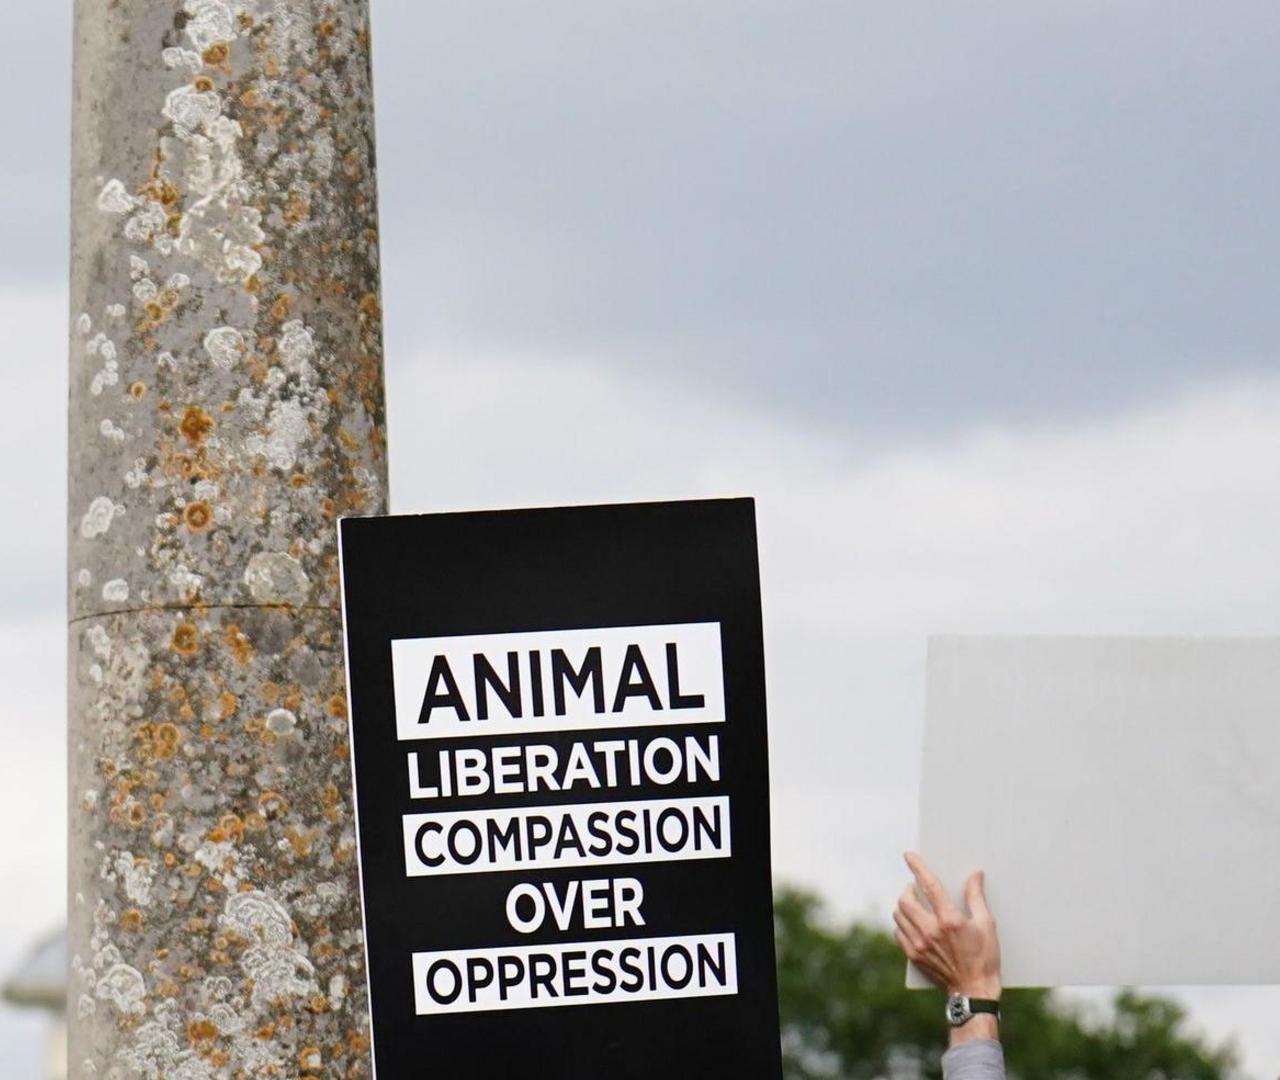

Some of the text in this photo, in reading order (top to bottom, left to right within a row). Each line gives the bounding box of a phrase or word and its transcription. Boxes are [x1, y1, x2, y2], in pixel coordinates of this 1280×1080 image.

[418, 643, 705, 724] ANIMAL
[408, 735, 720, 798] LIBERATION
[414, 805, 722, 867] COMPASSION
[506, 878, 646, 934] OVER
[426, 943, 726, 1005] OPPRESSION
